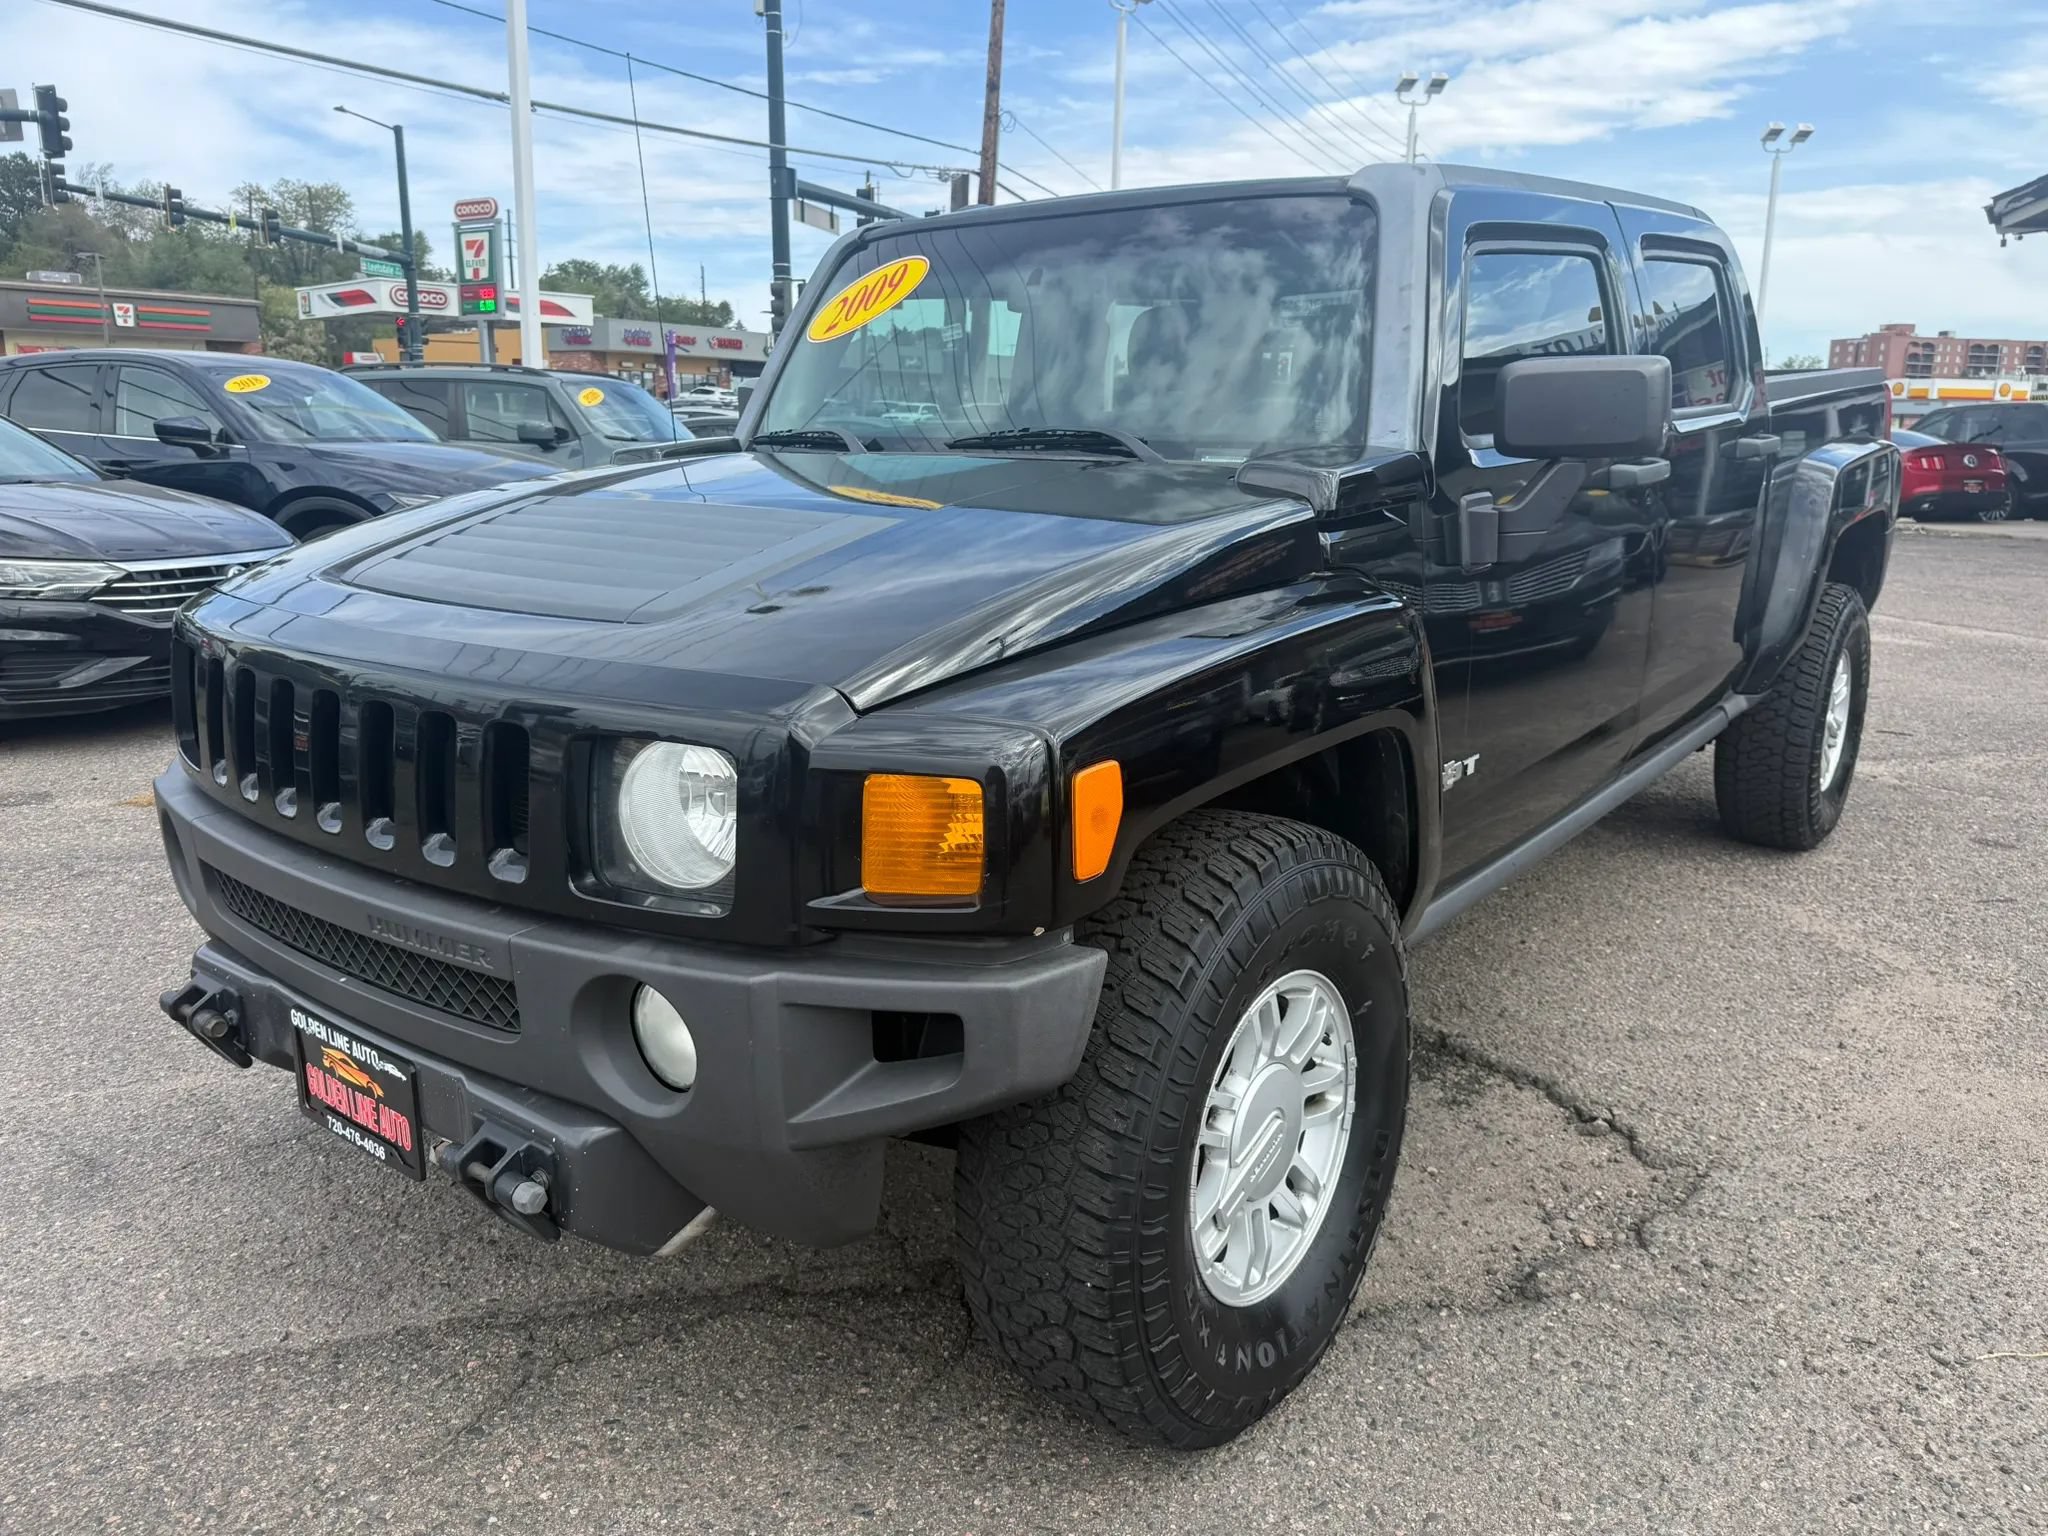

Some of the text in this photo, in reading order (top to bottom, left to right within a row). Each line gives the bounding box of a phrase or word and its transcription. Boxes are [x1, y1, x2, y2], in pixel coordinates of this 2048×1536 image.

[824, 263, 908, 335] 2009
[368, 913, 494, 969] HUMMER
[291, 1009, 379, 1069] GOLDEN LINE AUTO
[306, 1062, 412, 1151] GOLDEN LINE AUTO
[327, 1115, 385, 1160] 720-476-4036
